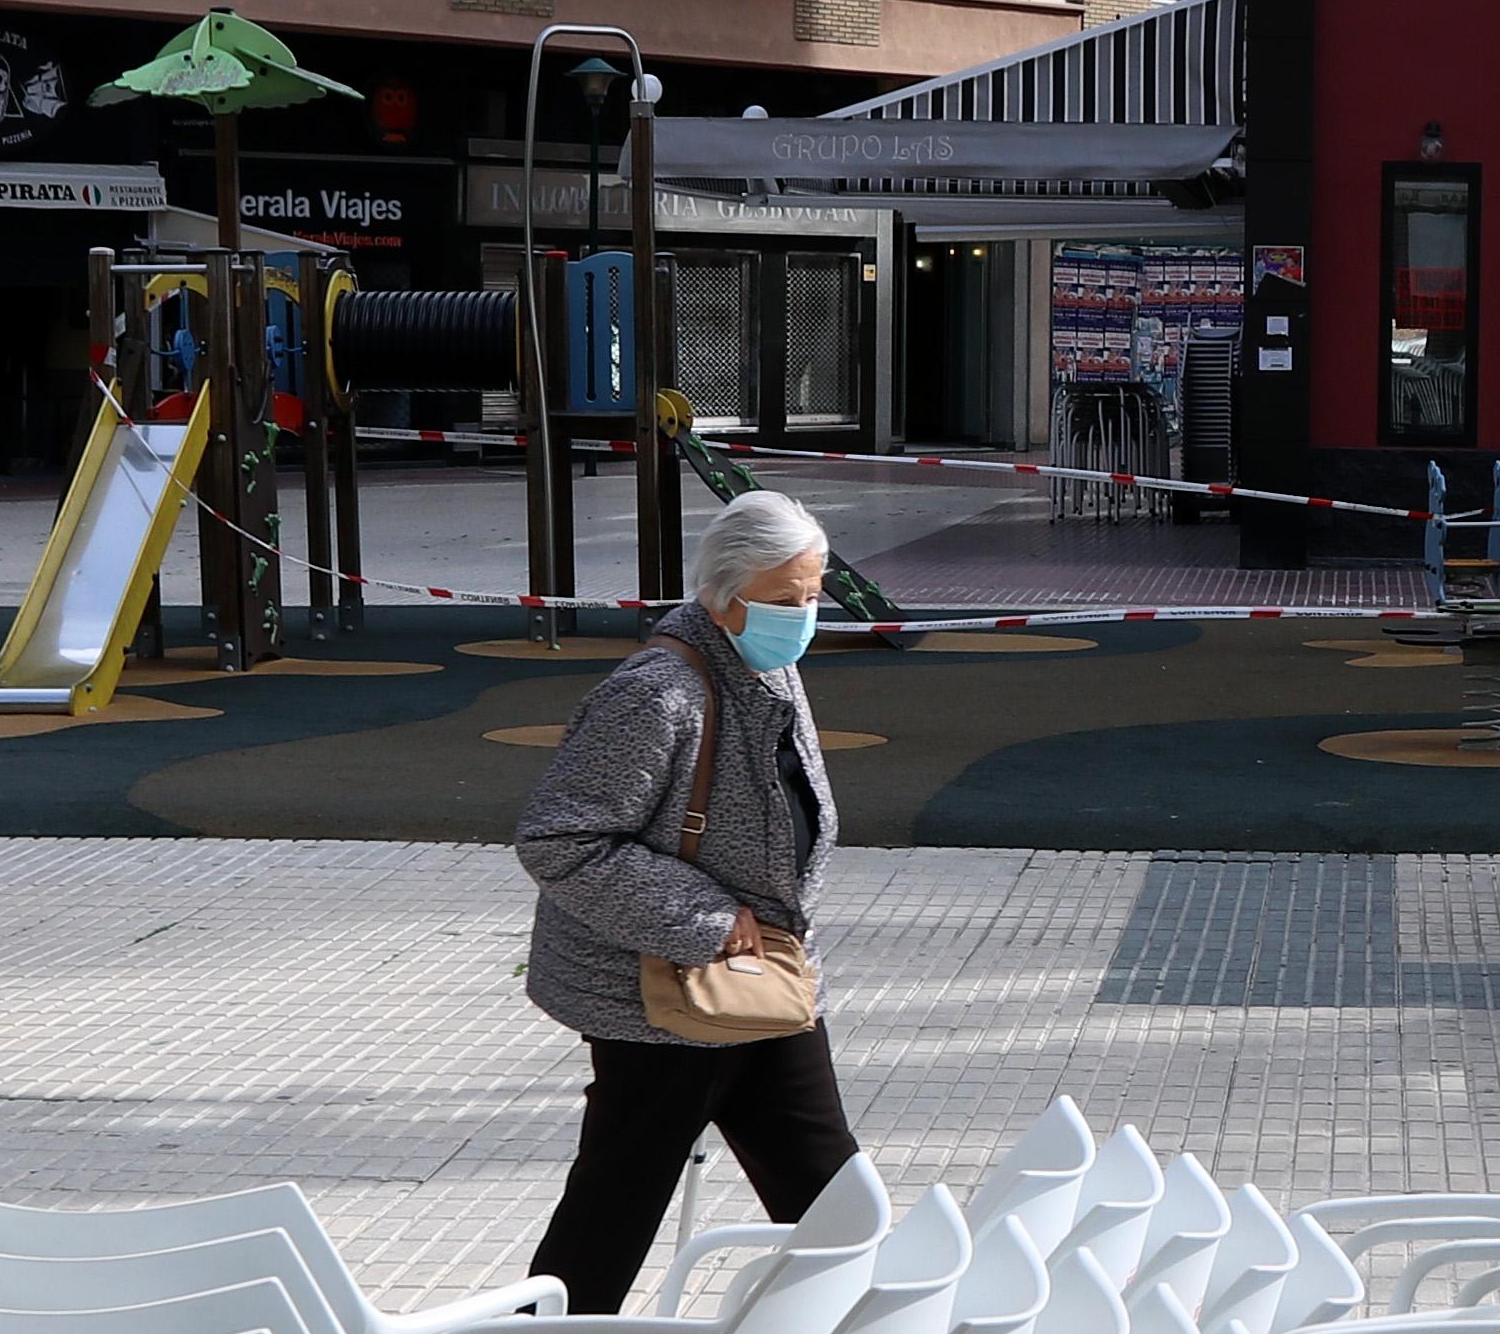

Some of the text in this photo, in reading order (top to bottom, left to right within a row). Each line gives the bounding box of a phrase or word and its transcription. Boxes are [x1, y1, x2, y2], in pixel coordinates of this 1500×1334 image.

[771, 134, 882, 163] GRUPO
[240, 188, 403, 227] erala Viajes
